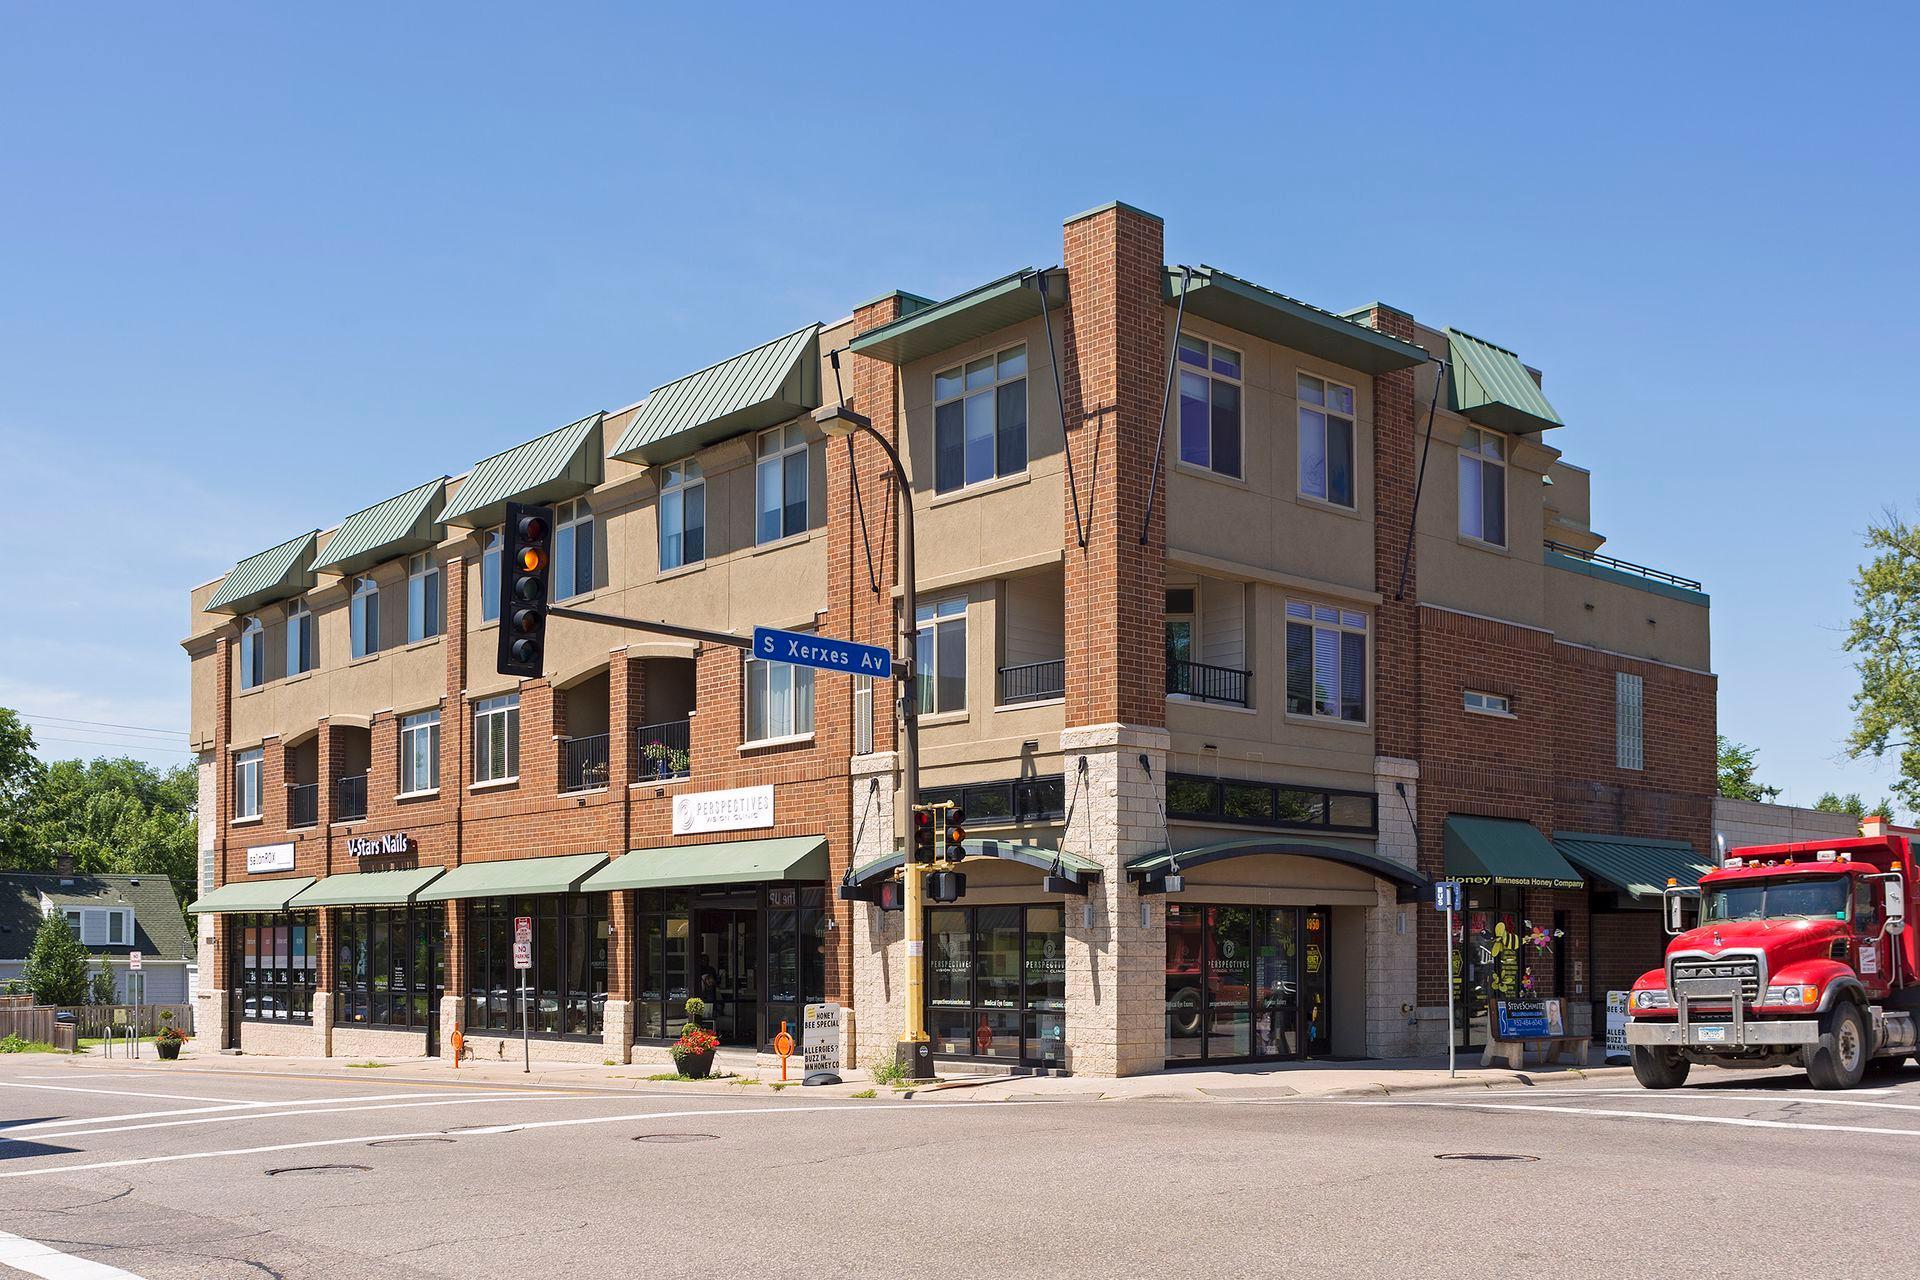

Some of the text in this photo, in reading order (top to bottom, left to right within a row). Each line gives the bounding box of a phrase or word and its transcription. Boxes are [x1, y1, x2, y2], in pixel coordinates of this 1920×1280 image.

[763, 636, 883, 670] S Xerxes Av
[696, 796, 769, 816] PERSPECTIVES
[382, 832, 407, 854] Nails
[1445, 876, 1491, 885] Honey
[1495, 876, 1585, 889] Minnesota Honey Company
[1677, 966, 1754, 977] MACK
[816, 1012, 835, 1020] HONEY
[805, 1045, 839, 1053] ALLERGIES?
